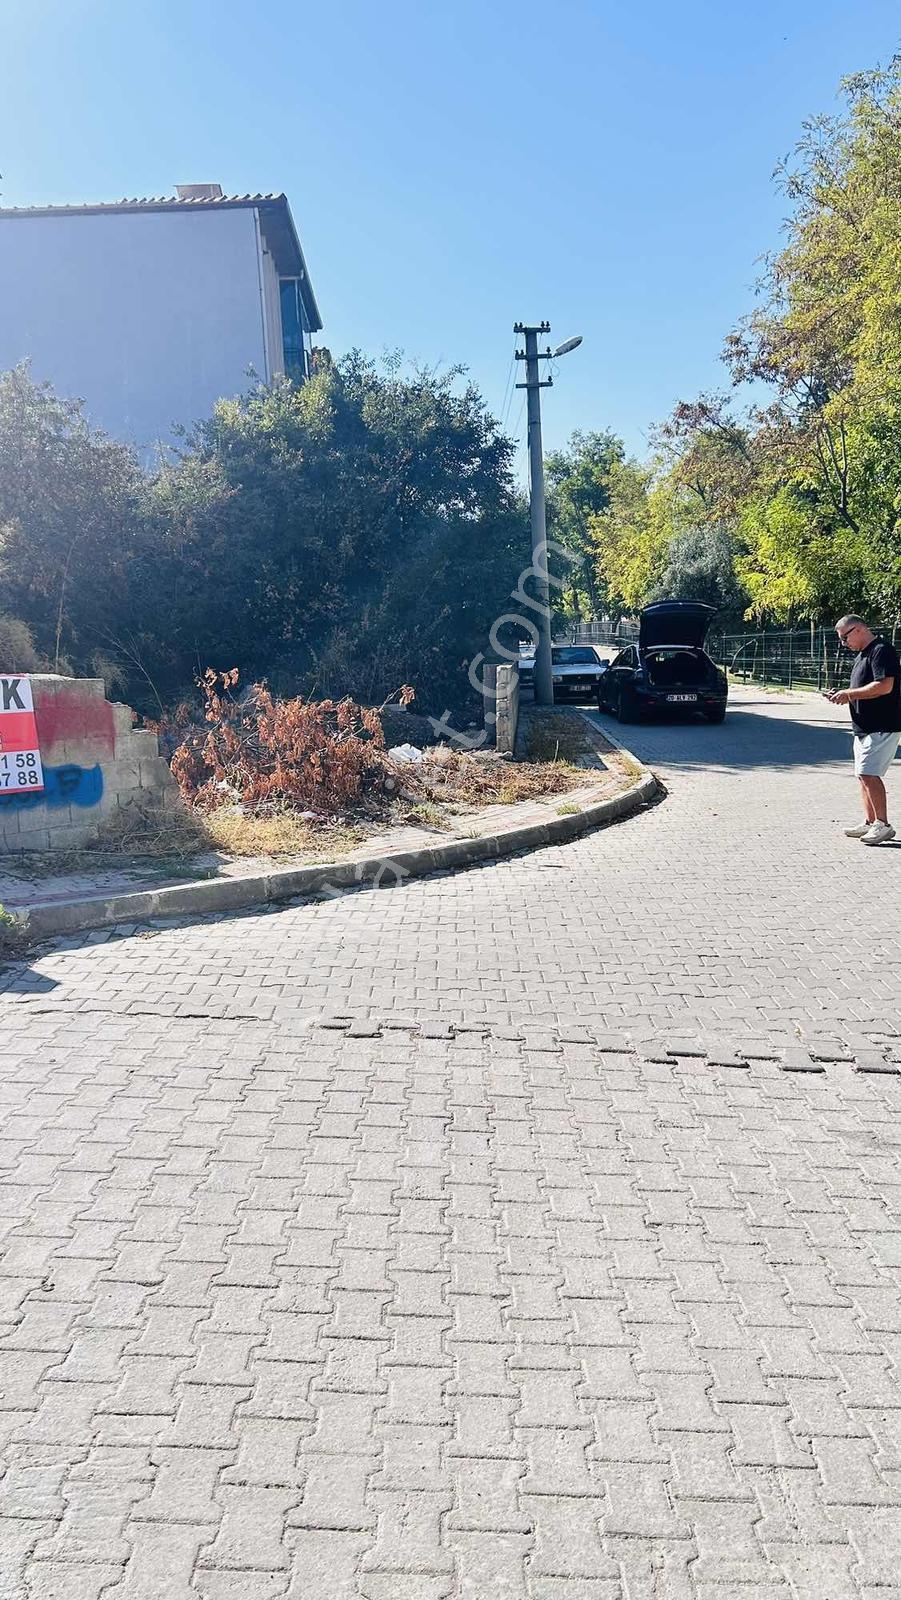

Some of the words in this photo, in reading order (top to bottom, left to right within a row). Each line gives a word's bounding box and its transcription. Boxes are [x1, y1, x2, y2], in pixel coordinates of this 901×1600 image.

[15, 752, 36, 768] 58
[0, 772, 11, 787] 7
[17, 770, 38, 786] 88
